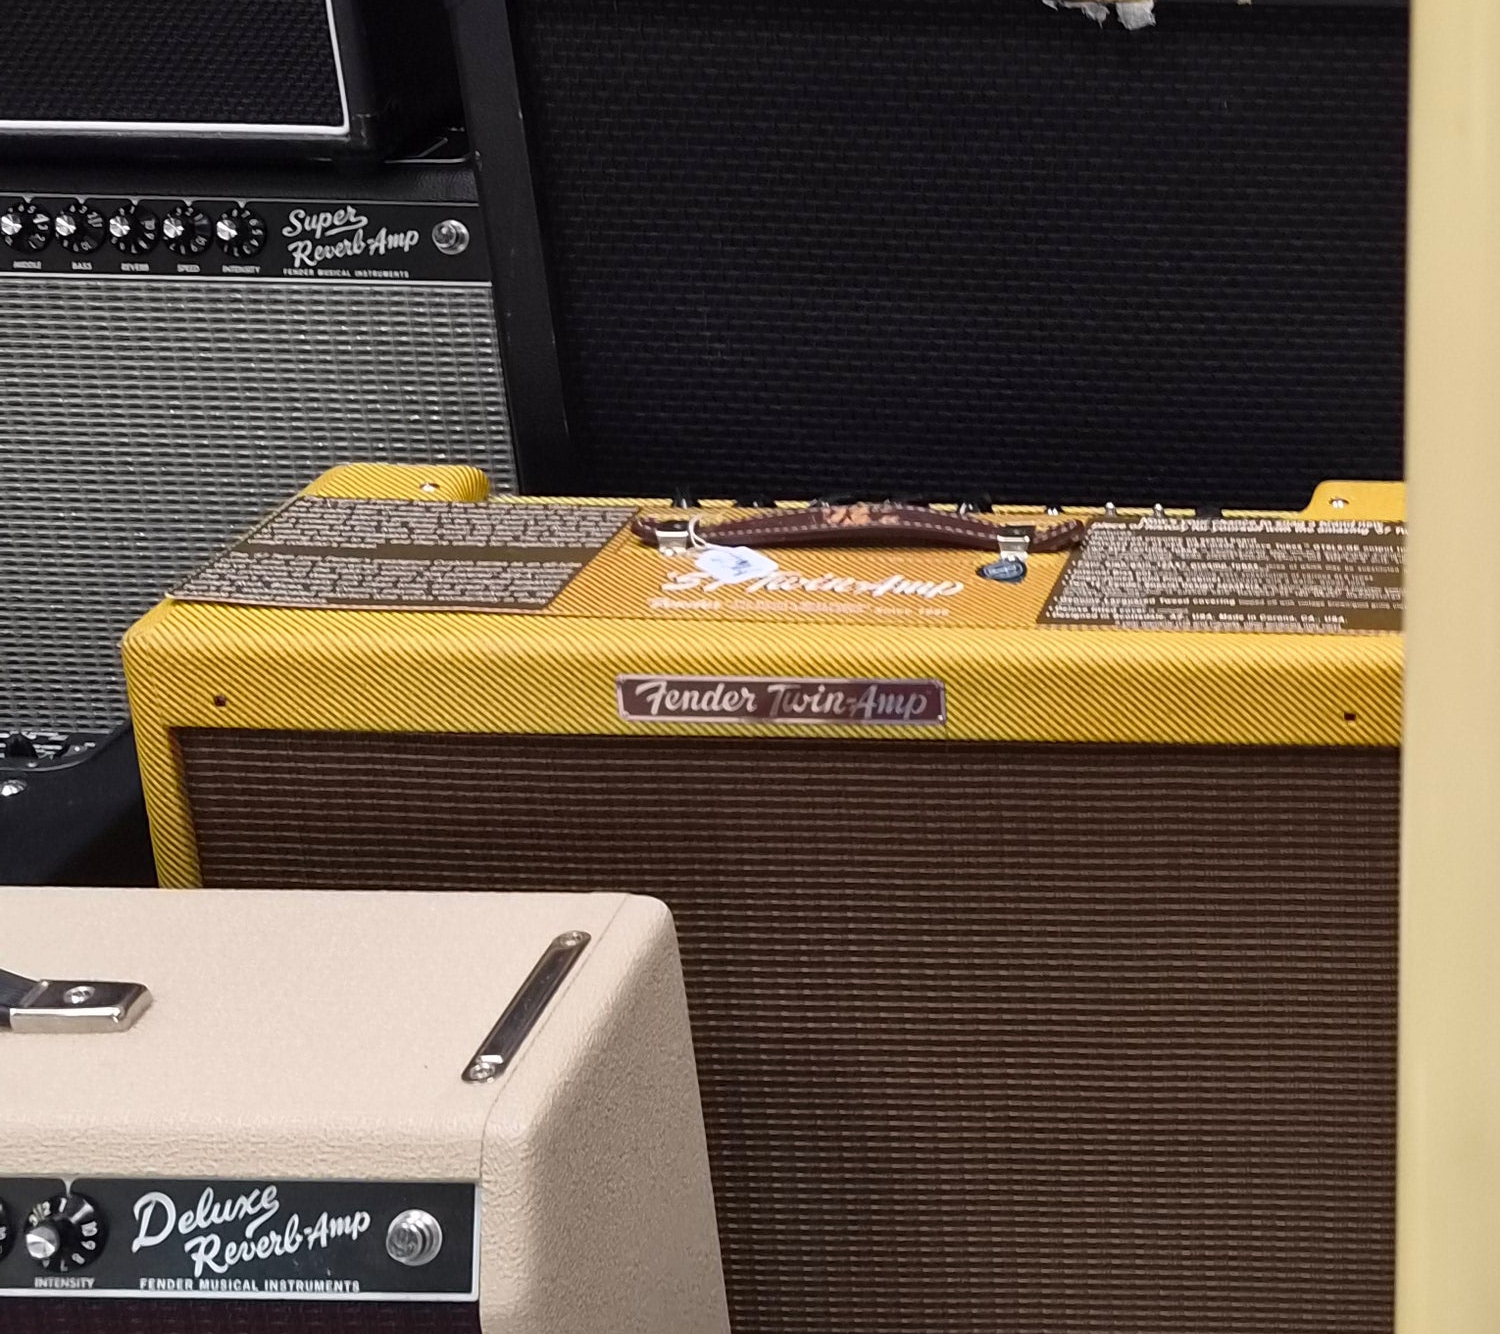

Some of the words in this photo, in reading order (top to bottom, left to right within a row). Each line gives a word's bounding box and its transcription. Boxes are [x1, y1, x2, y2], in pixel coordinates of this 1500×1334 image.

[282, 205, 368, 239] Super
[287, 227, 419, 268] Reverb-Amp
[354, 270, 409, 278] INSTRUMENTS
[636, 679, 757, 716] Fender
[767, 682, 928, 719] Twin-Amp
[132, 1184, 281, 1254] Deluxe
[185, 1210, 371, 1278] Reverb-Amp
[34, 1276, 95, 1289] INTENSITY
[139, 1278, 194, 1292] FENDER
[199, 1278, 259, 1292] MUSICAL
[264, 1279, 360, 1293] INSTRUMENTS
